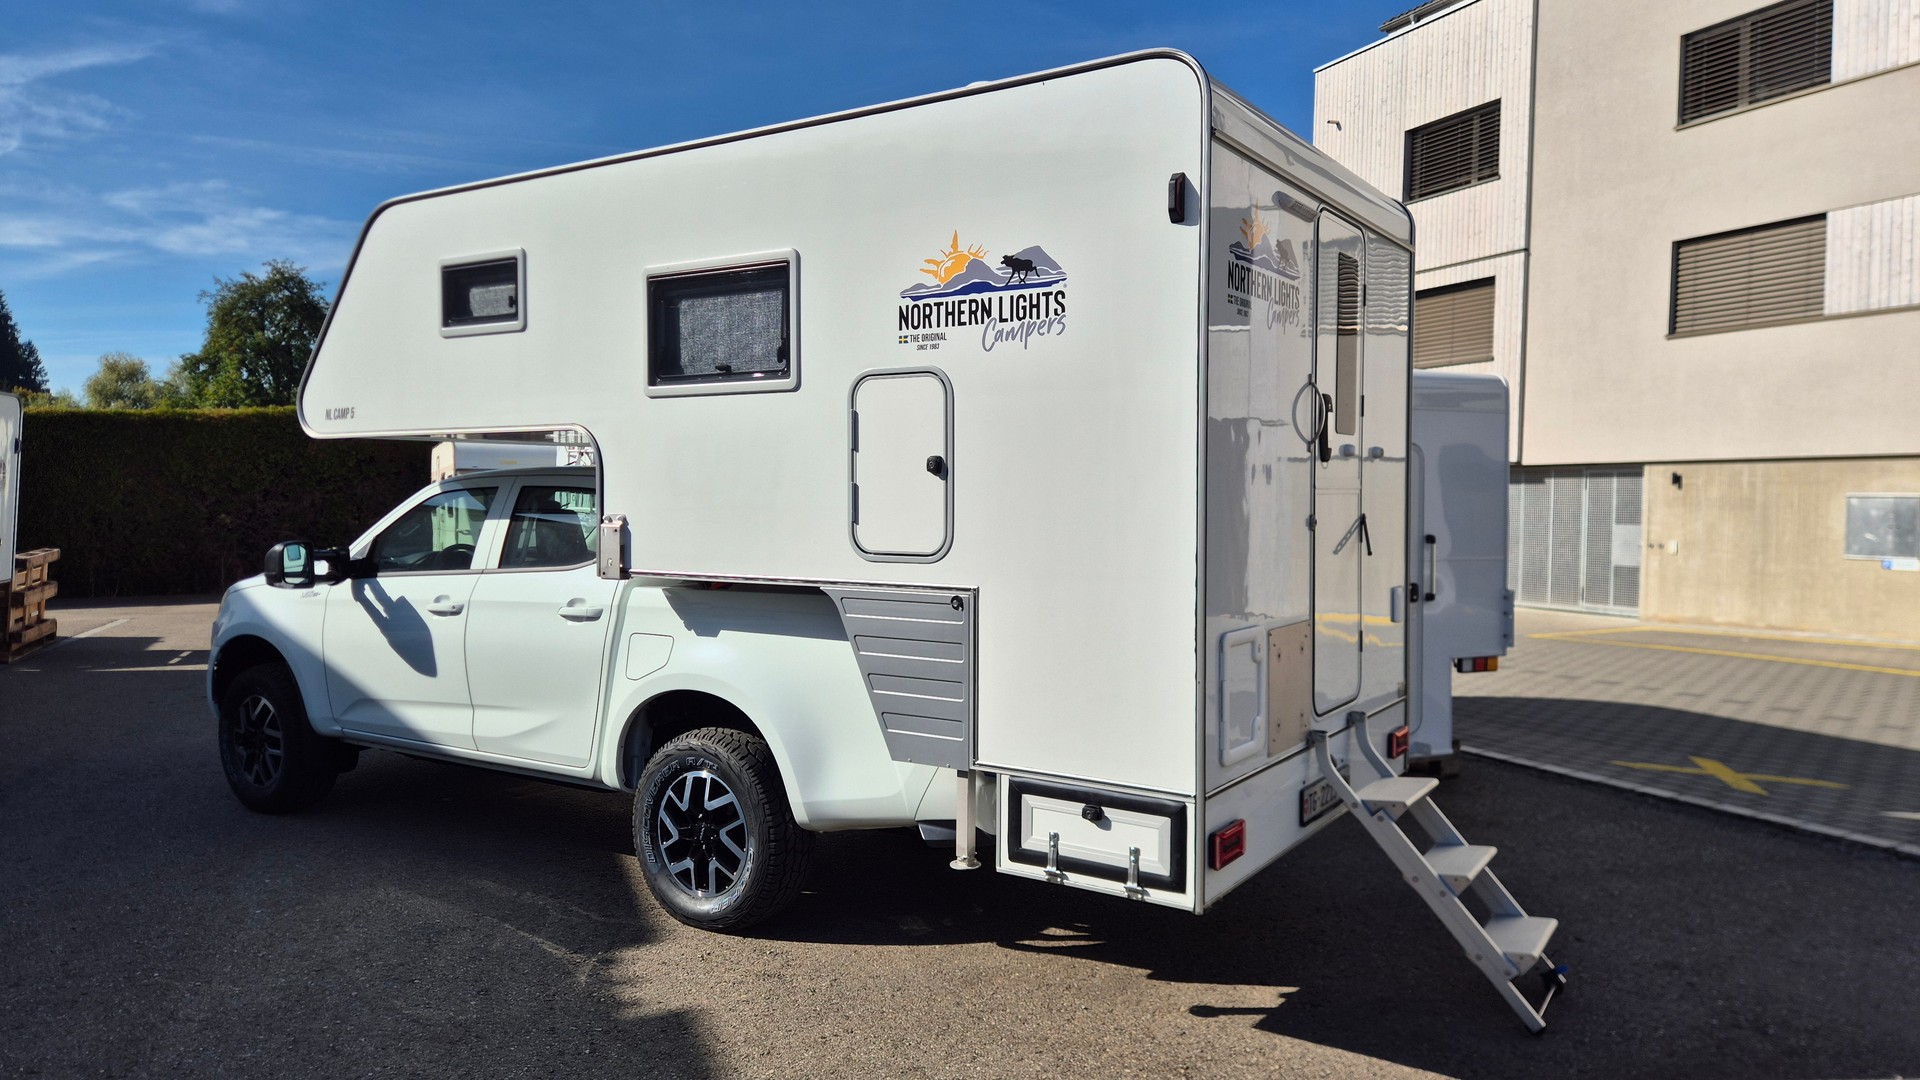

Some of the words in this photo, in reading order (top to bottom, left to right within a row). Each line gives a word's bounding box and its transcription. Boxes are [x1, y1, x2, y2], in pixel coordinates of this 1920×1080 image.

[1227, 260, 1273, 301] NORTHERN
[1274, 278, 1300, 310] LIGHTS
[898, 296, 992, 331] NORTHERN
[998, 290, 1066, 323] LIGHTS
[910, 334, 920, 343] THE
[921, 332, 947, 343] ORIGINAL
[981, 314, 1067, 352] Campers
[325, 408, 332, 421] NL
[333, 407, 349, 421] CAMP
[643, 760, 681, 863] DISCOVERER
